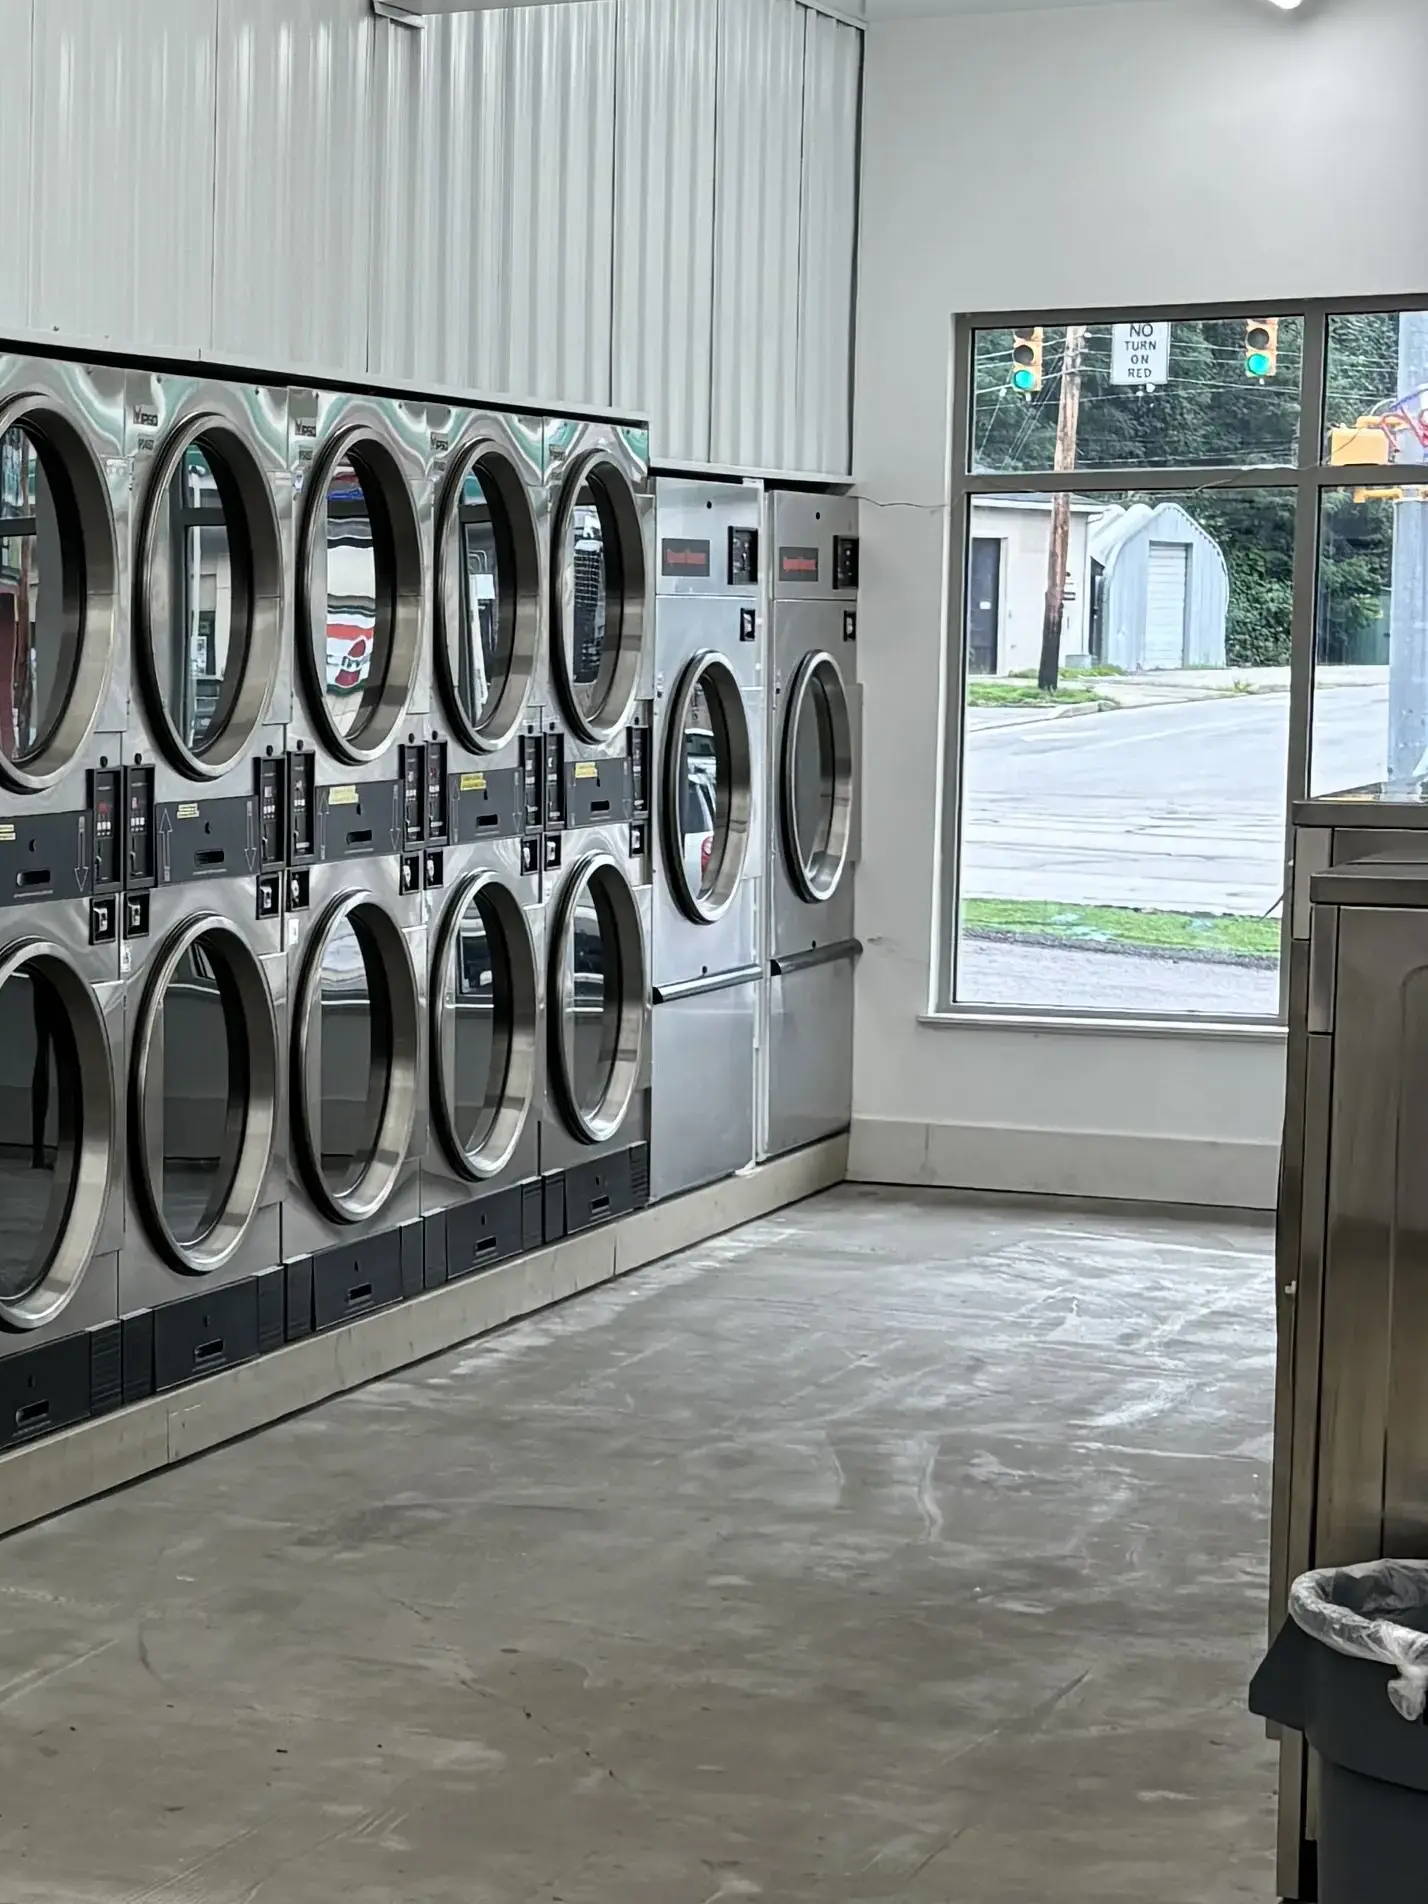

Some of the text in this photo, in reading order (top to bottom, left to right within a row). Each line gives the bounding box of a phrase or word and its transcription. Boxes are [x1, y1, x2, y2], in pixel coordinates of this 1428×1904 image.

[1129, 323, 1154, 337] NO
[1124, 340, 1157, 351] TURN
[1130, 354, 1149, 364] ON
[1127, 367, 1152, 378] RED
